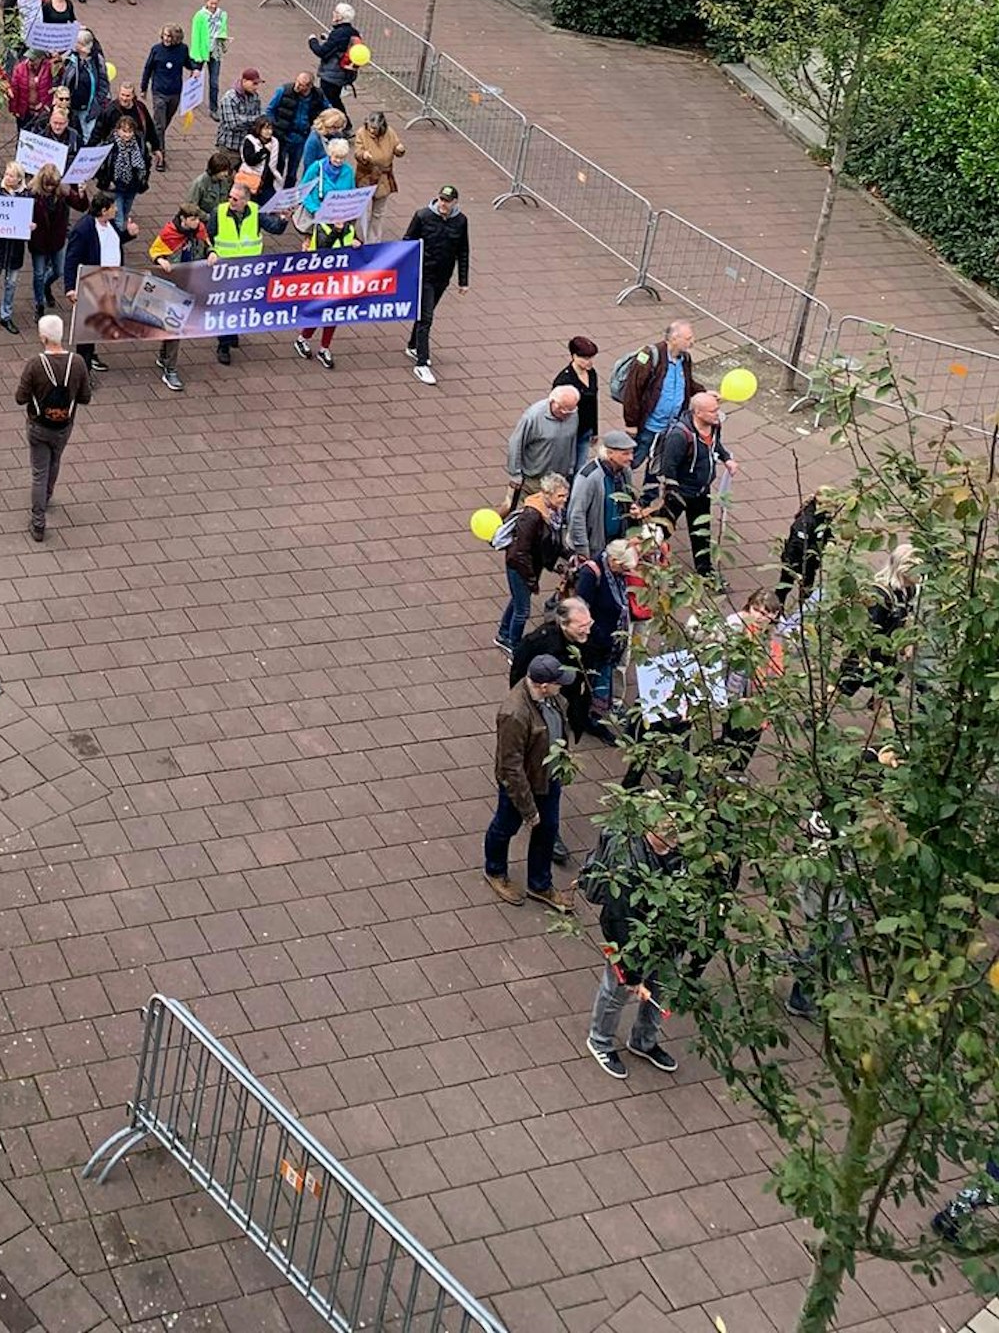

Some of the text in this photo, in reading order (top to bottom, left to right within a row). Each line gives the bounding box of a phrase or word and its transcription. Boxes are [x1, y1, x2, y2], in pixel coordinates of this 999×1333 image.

[211, 253, 349, 282] Unser Leben
[206, 273, 393, 305] muss bezahlbar
[164, 307, 185, 328] 20
[204, 301, 412, 331] bleiben! REK-NRW
